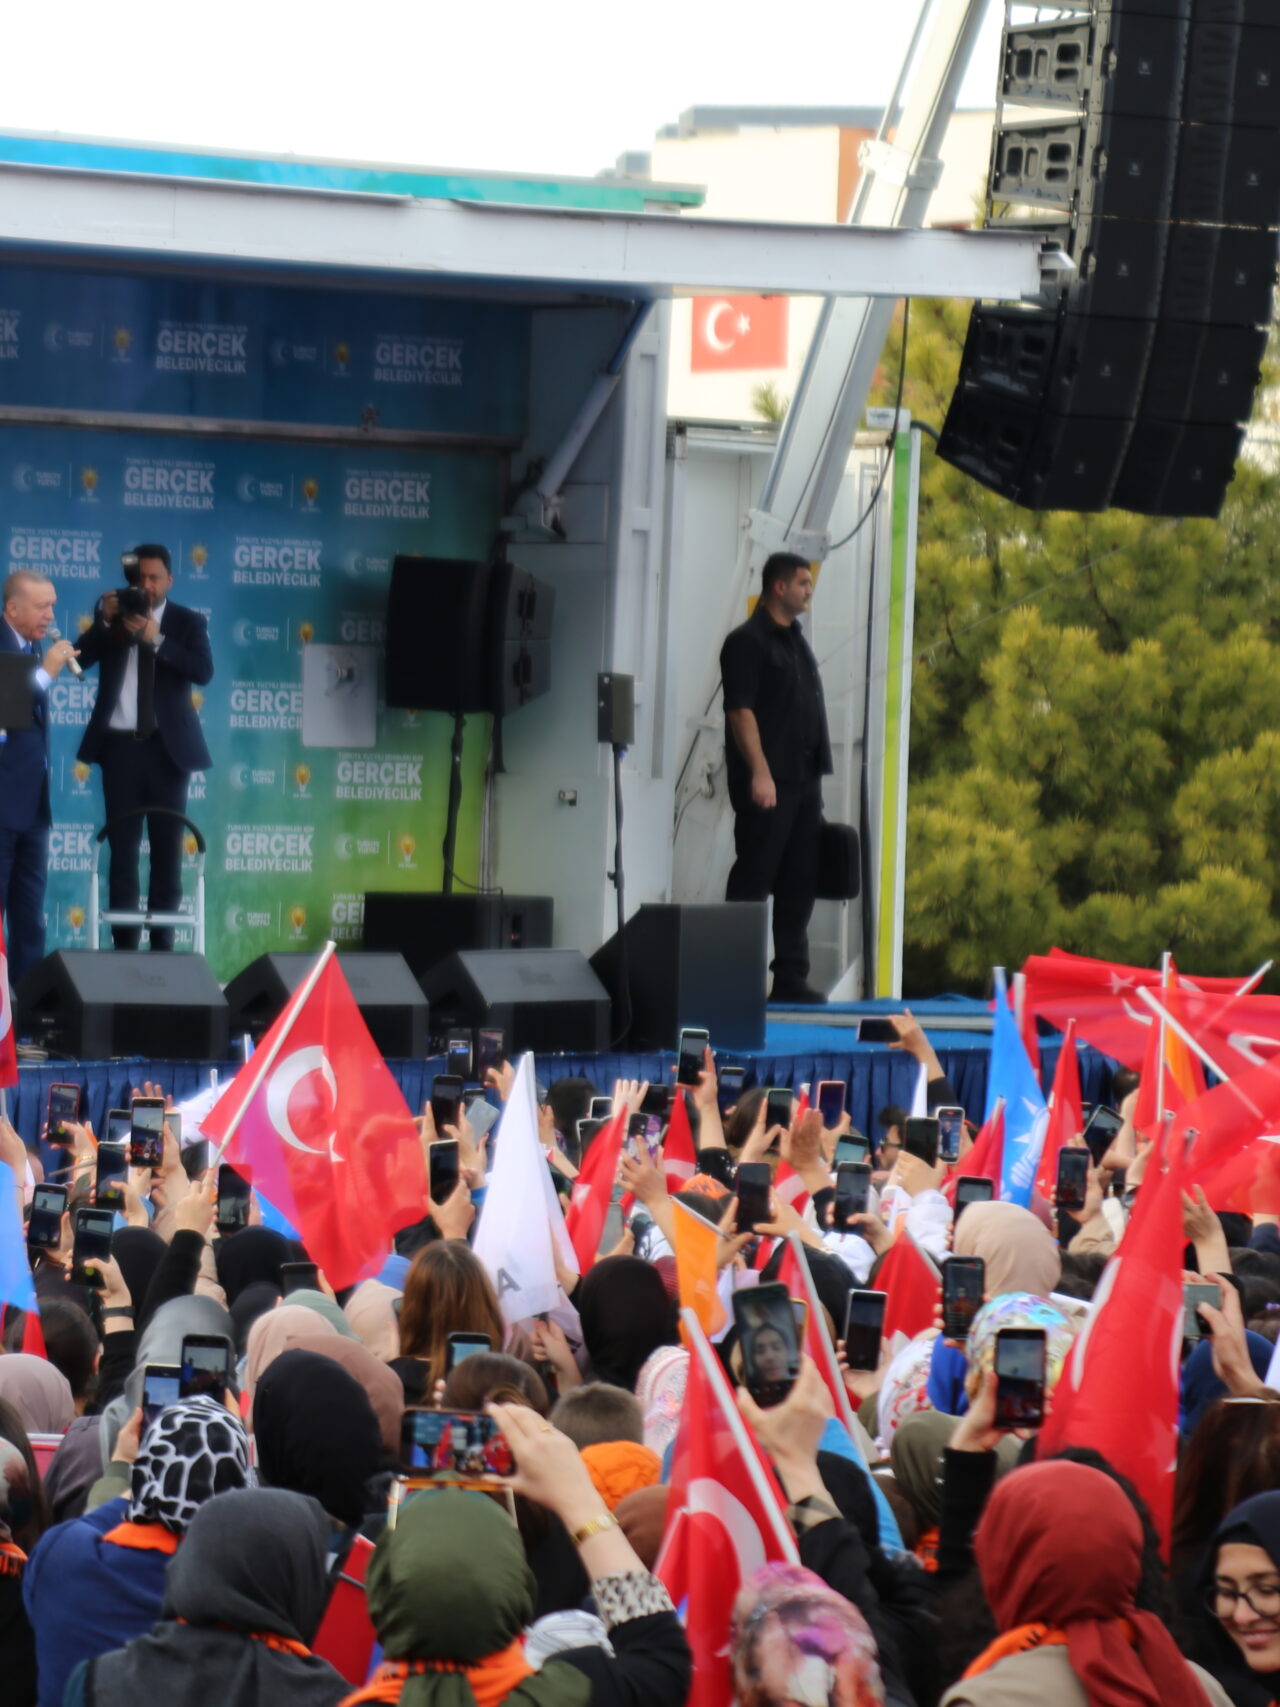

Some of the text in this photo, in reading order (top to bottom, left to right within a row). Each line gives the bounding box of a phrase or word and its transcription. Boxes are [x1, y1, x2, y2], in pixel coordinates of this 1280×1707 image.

[157, 329, 247, 357] GERÇEK
[376, 342, 463, 370] GERÇEK
[125, 466, 214, 494] GERÇEK
[346, 477, 429, 504] GERÇEK
[9, 535, 100, 563] GERÇEK
[235, 545, 320, 572] GERÇEK
[230, 690, 303, 714] GERÇE
[337, 761, 421, 786] GERÇEK
[226, 833, 312, 858] GERÇEK
